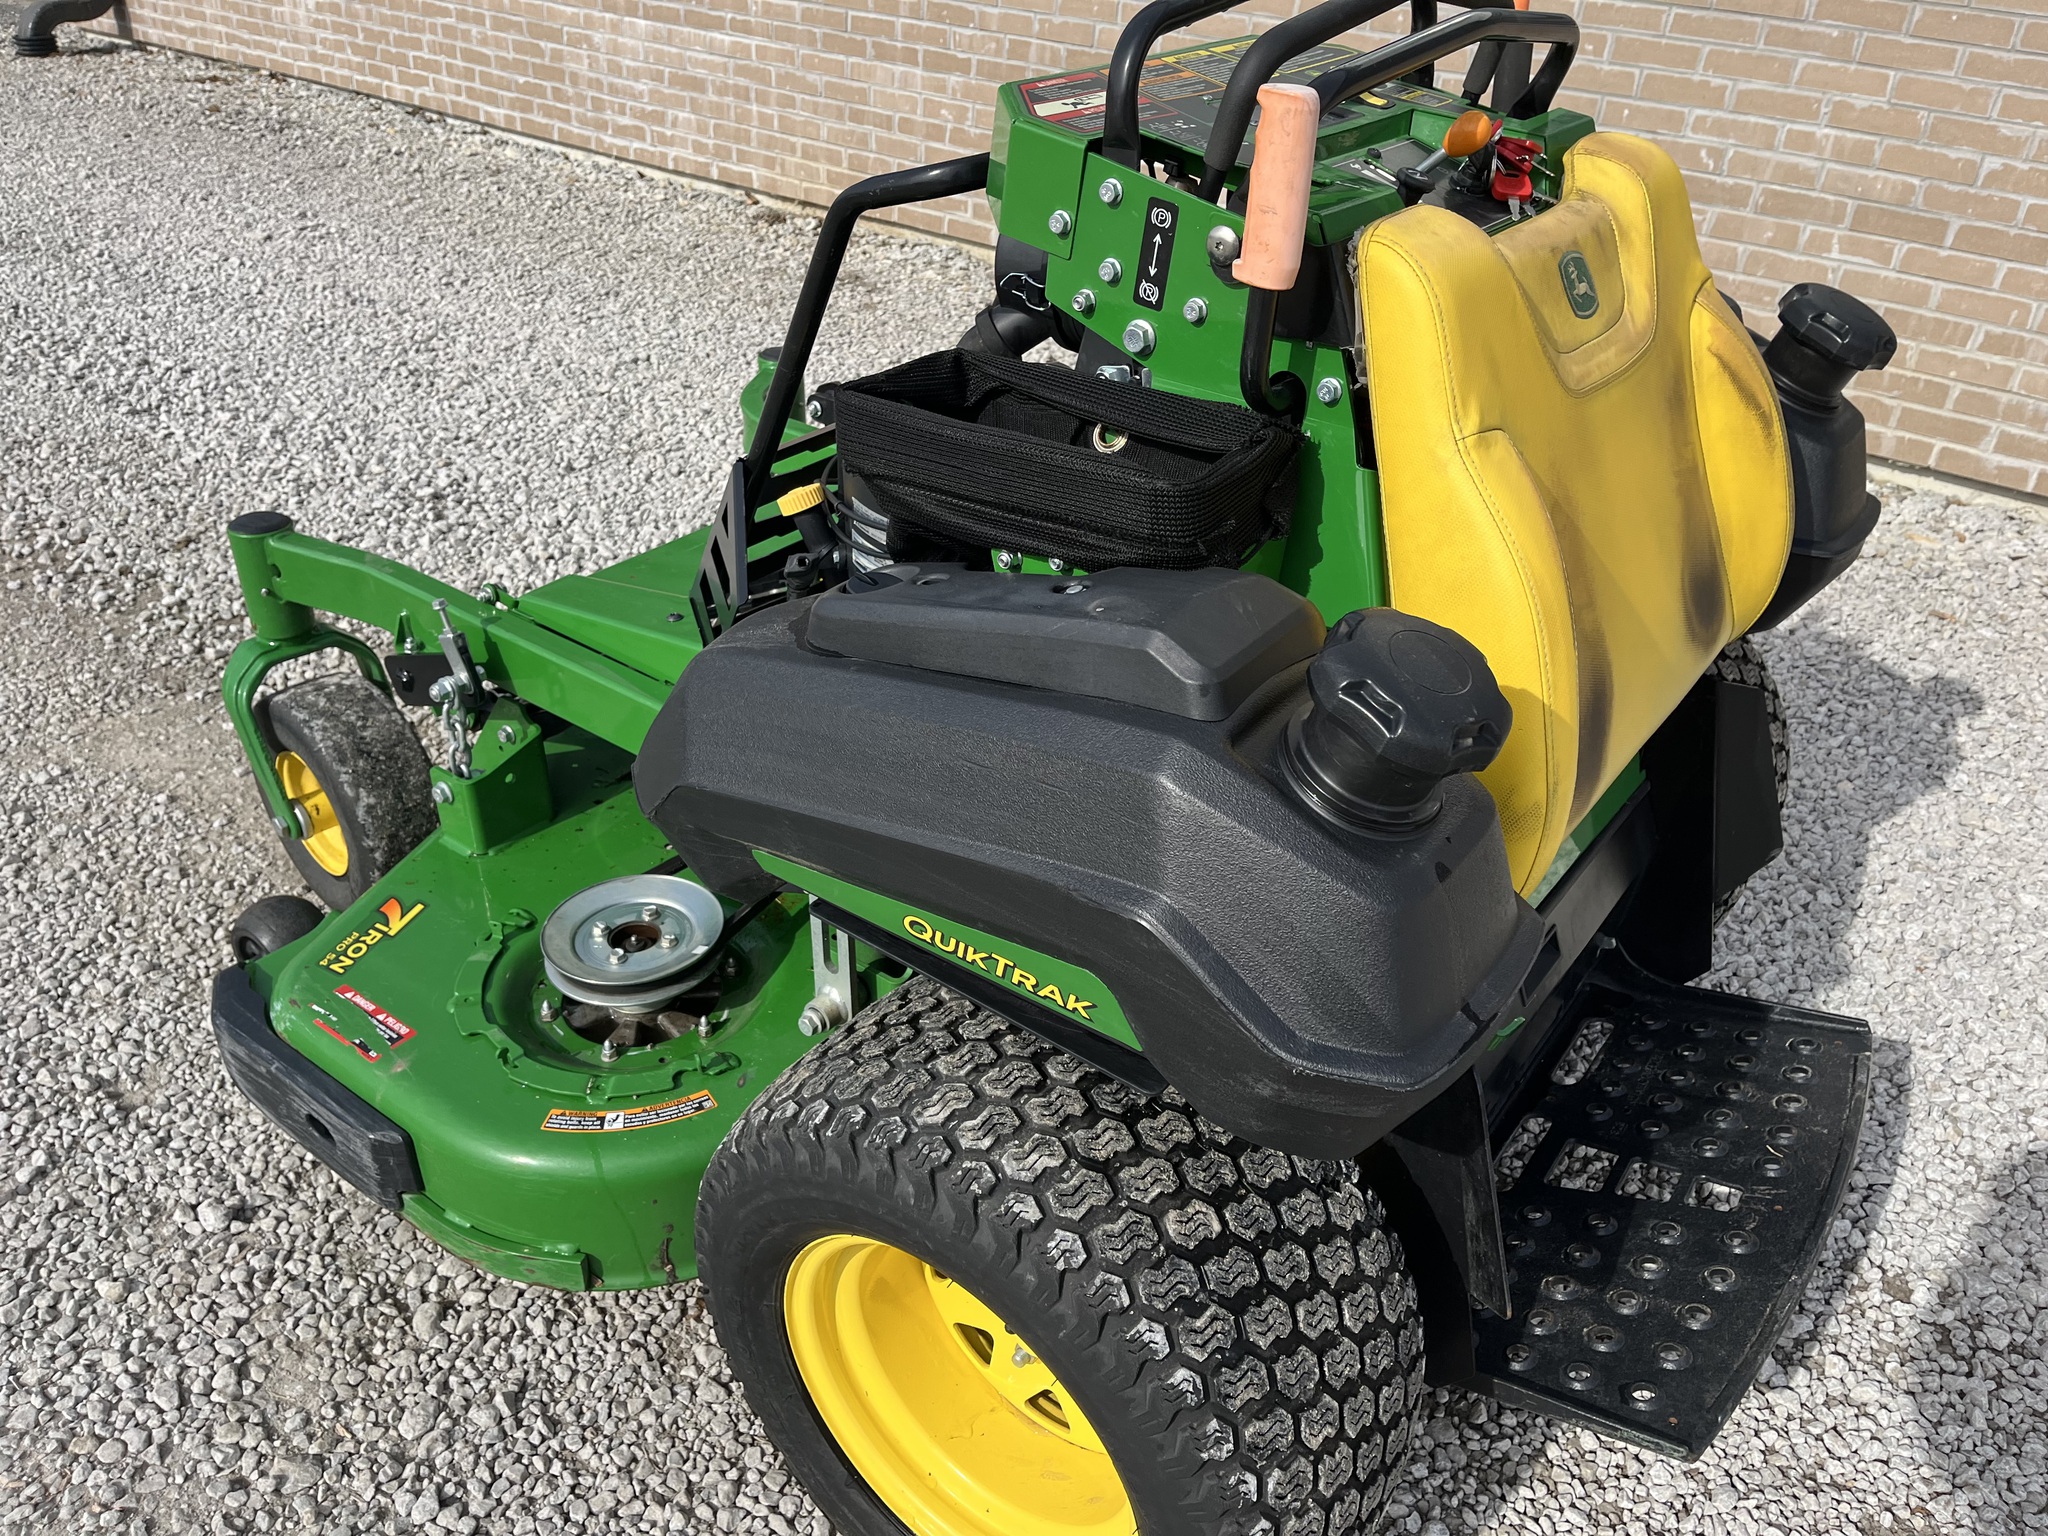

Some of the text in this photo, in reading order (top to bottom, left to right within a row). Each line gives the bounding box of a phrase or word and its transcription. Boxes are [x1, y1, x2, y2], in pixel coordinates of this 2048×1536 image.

[319, 931, 360, 966] PRO 54
[902, 915, 1097, 1022] QUIKTRAK
[351, 994, 377, 1012] DANGER
[383, 1016, 410, 1035] PELIGRO
[648, 1096, 692, 1111] ADVERTENCIA
